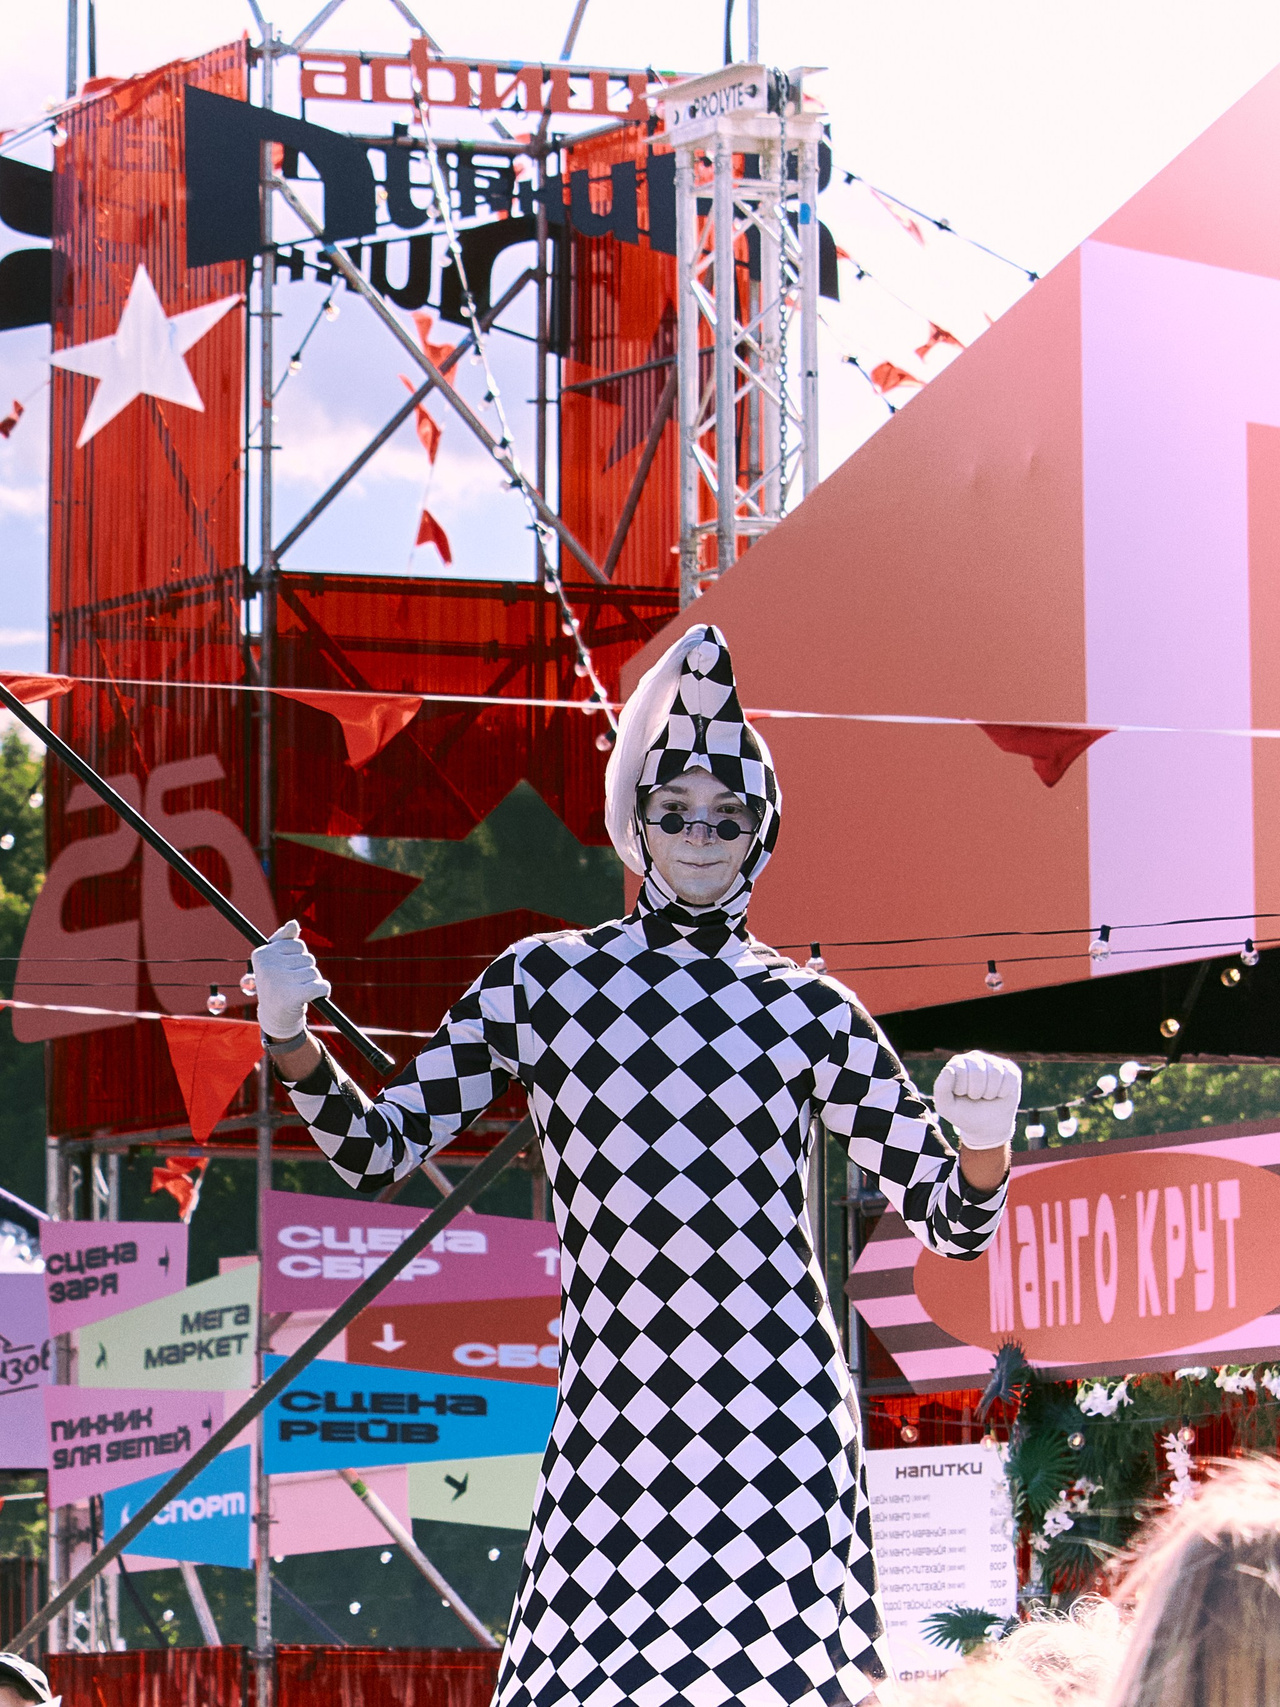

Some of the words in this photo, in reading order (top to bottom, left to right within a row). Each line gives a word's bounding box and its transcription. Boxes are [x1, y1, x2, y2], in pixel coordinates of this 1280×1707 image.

[300, 37, 652, 123] афиш
[693, 82, 743, 120] PROLYTE
[1136, 1179, 1241, 1317] КРУТ
[278, 1255, 441, 1281] СБР
[51, 1407, 153, 1442] ПИКНИК
[279, 1419, 440, 1444] РЕЙВ
[899, 1669, 949, 1682] ФРУК
